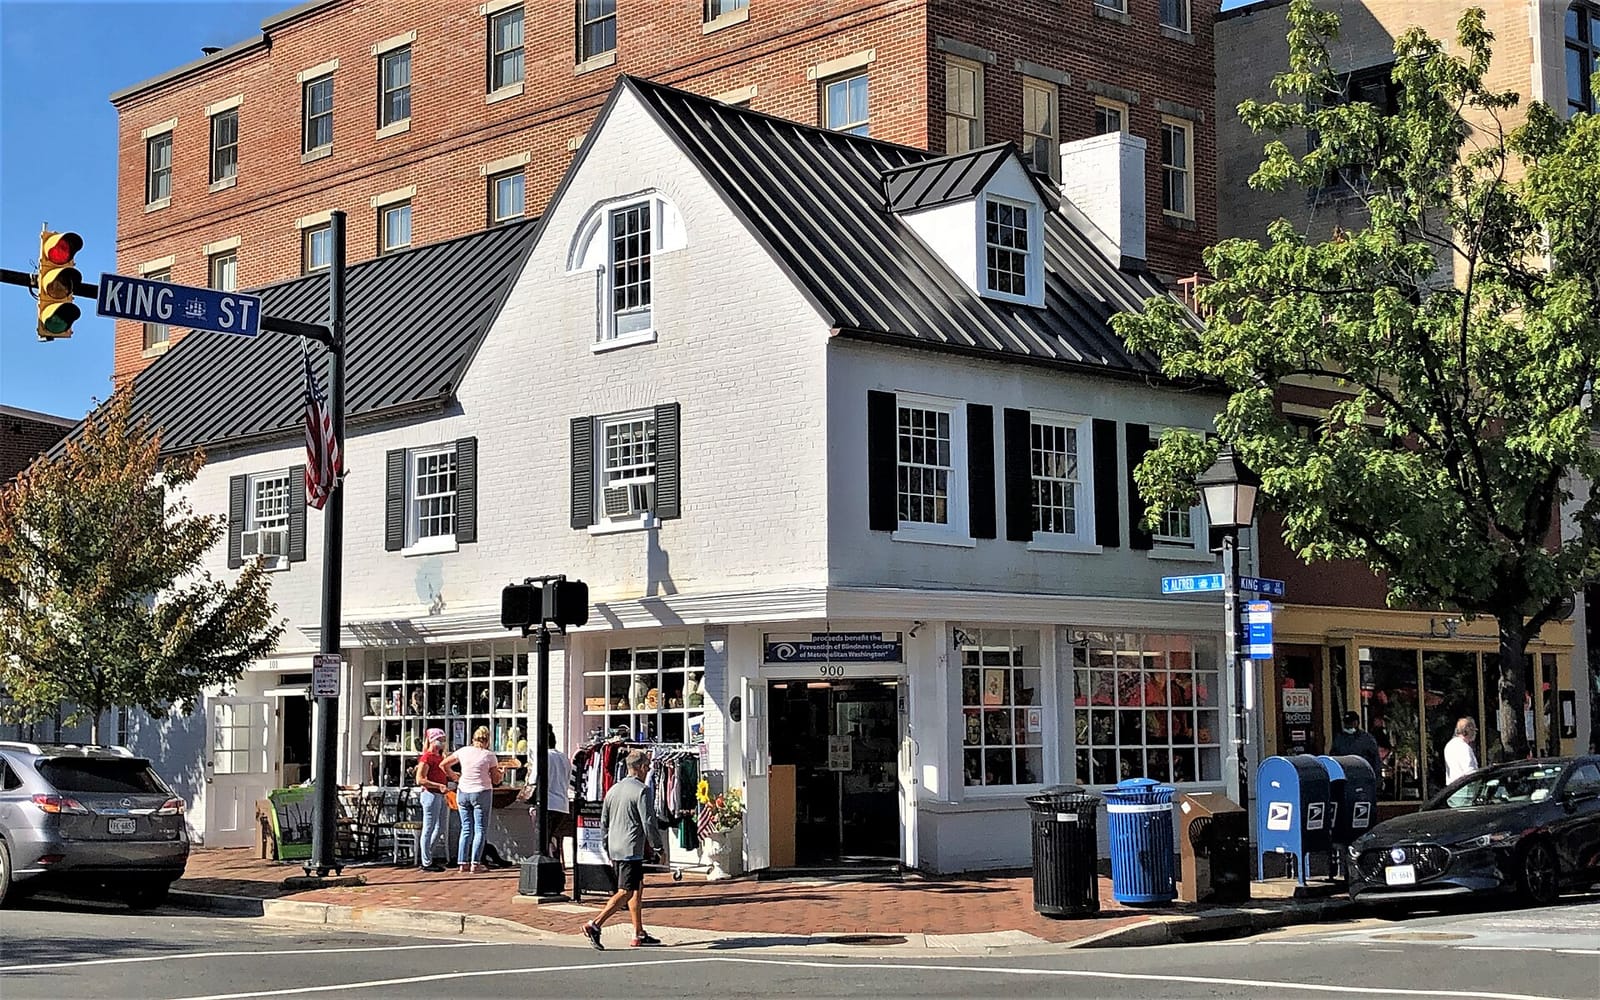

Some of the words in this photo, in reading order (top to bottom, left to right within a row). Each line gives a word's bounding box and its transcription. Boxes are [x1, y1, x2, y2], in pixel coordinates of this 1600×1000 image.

[104, 280, 174, 319] KING
[218, 297, 253, 330] ST
[1163, 579, 1169, 591] S
[1171, 578, 1194, 590] ALFRED
[1240, 577, 1258, 590] KING
[812, 634, 843, 642] proceeds
[872, 643, 895, 651] Society
[820, 665, 845, 676] 900
[1286, 695, 1309, 706] OPEN
